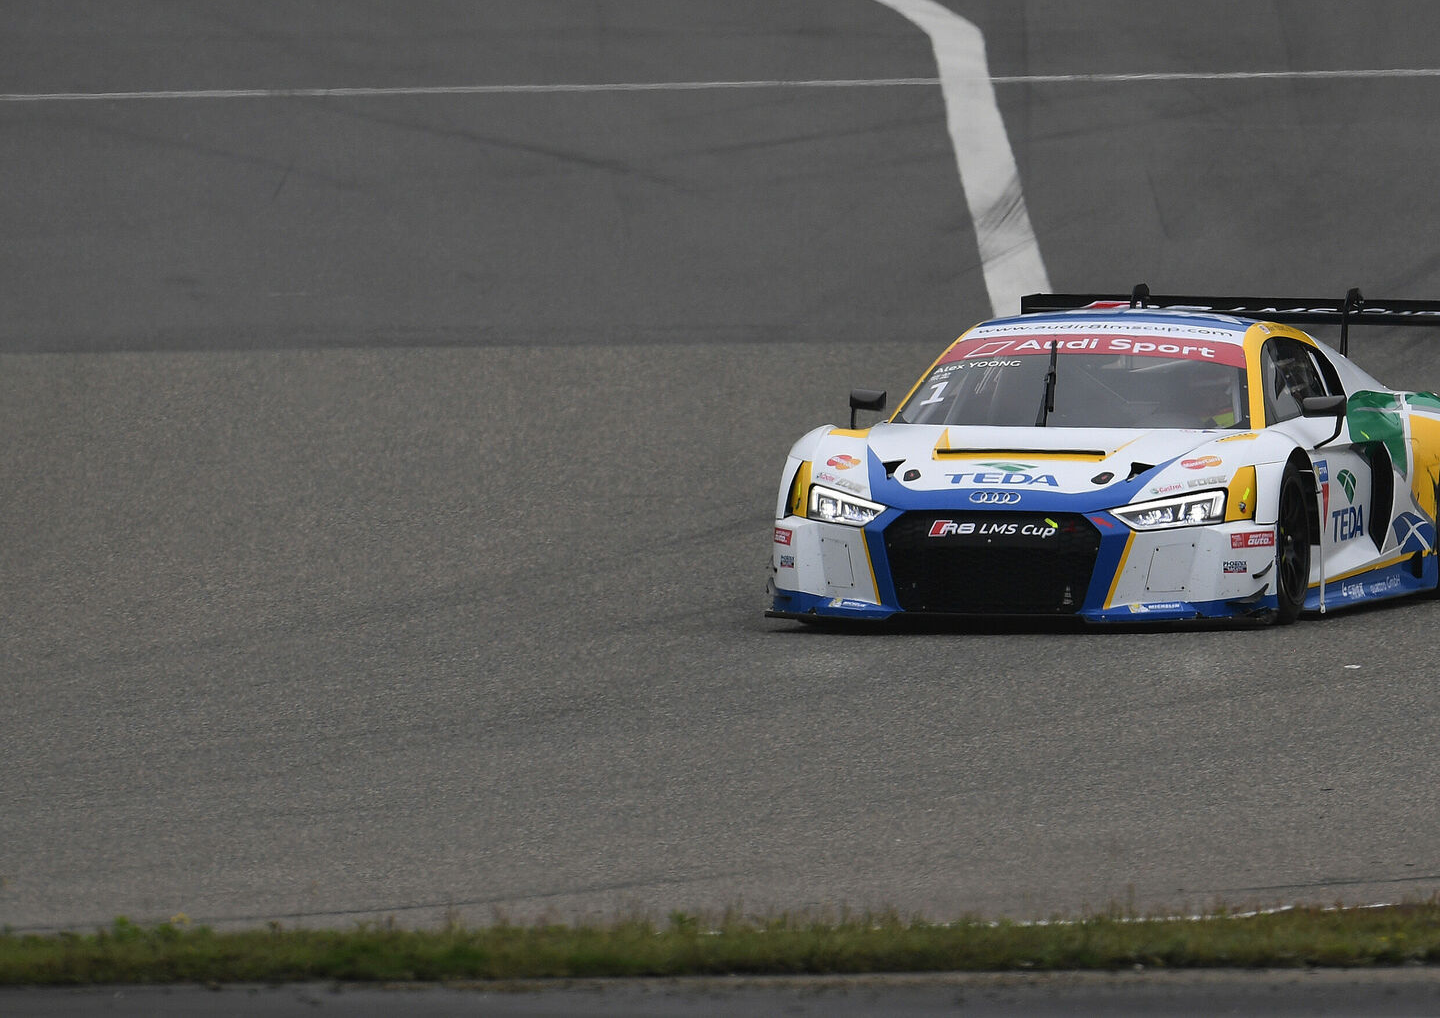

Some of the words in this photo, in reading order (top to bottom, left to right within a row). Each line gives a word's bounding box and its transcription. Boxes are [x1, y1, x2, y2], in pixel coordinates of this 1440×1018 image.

[977, 322, 1234, 338] www.audir8lmscup.com
[1013, 338, 1099, 351] Audi
[1107, 338, 1216, 358] Sport
[933, 364, 965, 375] Alex
[969, 360, 1022, 368] YOONG
[920, 381, 949, 406] 1
[944, 472, 1059, 487] TEDA
[935, 521, 976, 536] R8
[979, 523, 1019, 535] LMS
[1021, 524, 1057, 538] Cup
[1331, 504, 1364, 543] TEDA
